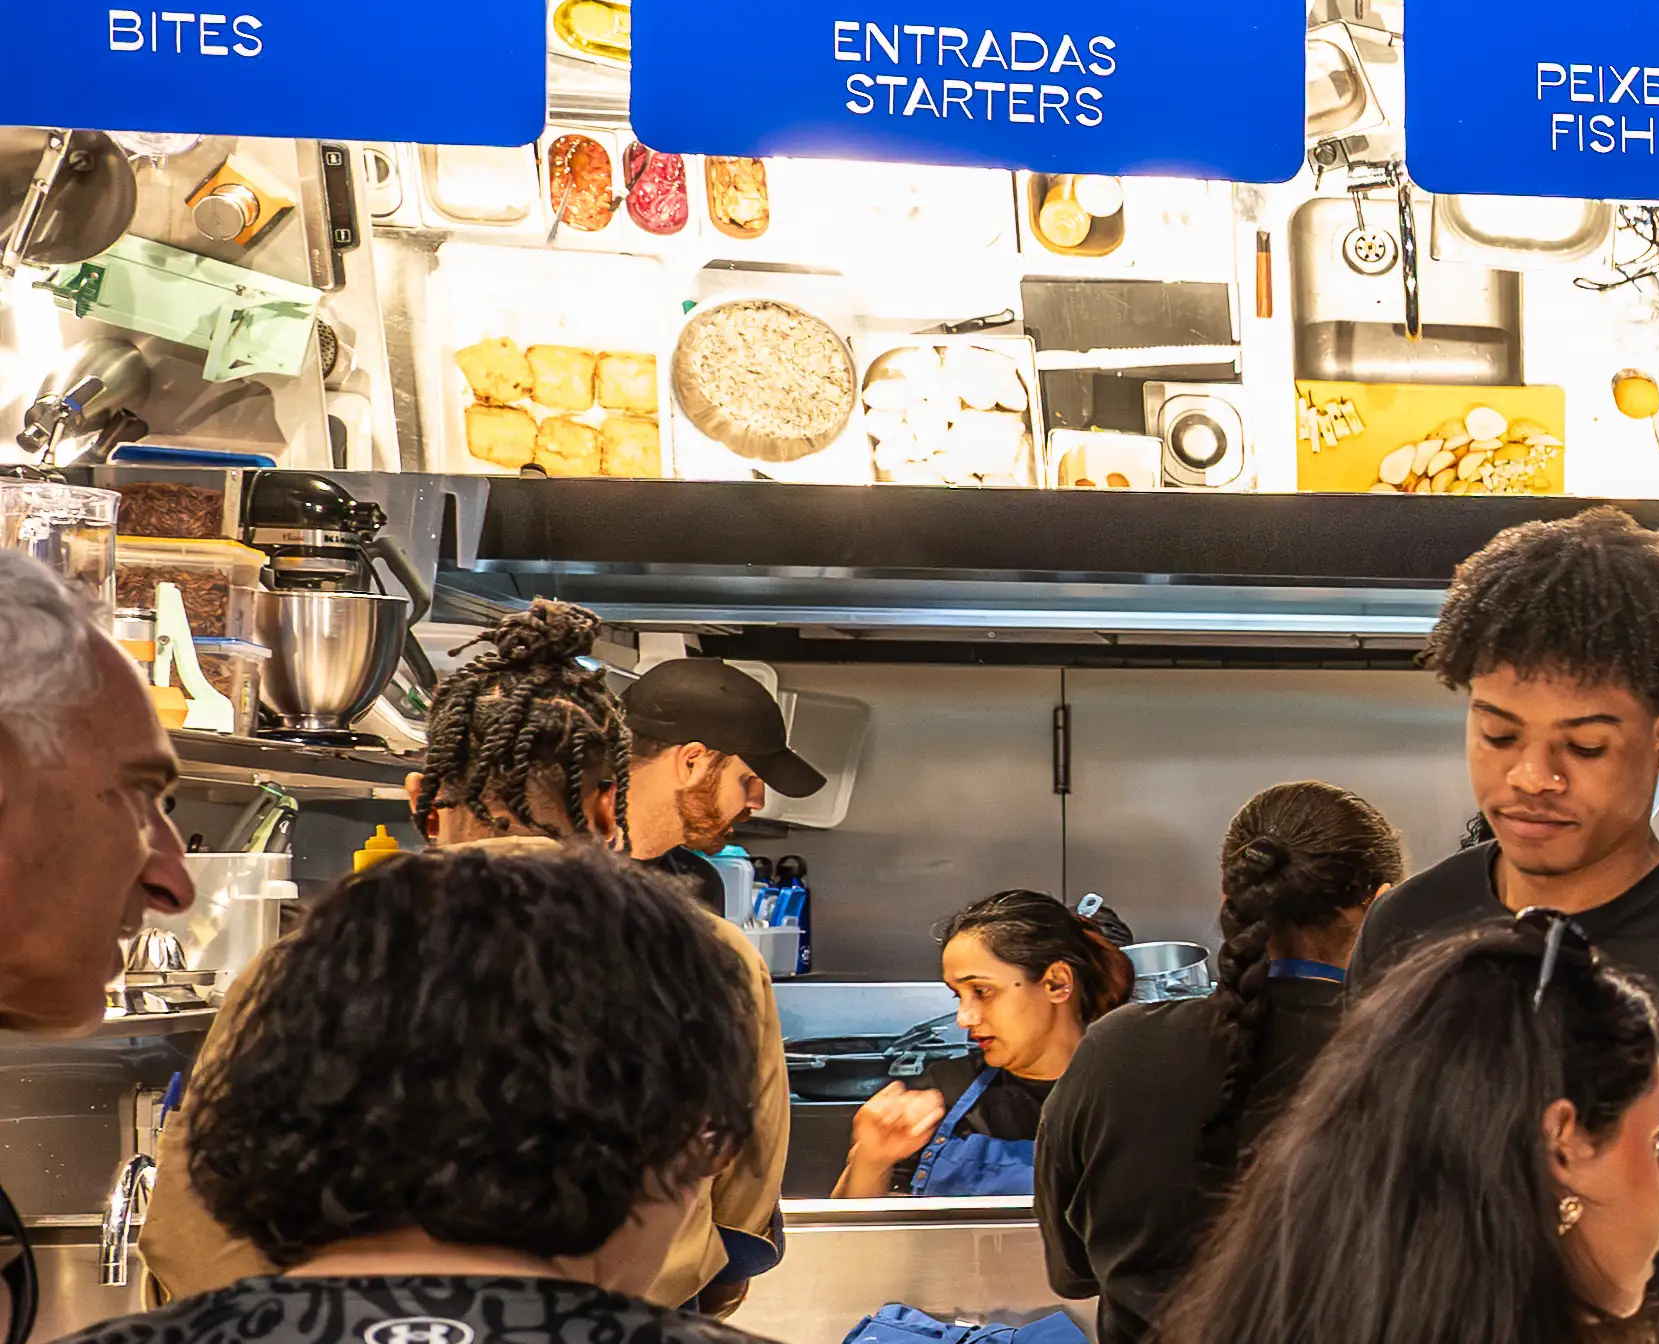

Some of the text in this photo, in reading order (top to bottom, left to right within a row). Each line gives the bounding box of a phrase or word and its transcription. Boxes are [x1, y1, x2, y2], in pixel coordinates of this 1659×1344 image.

[109, 10, 262, 56] BITES
[835, 21, 1115, 76] ENTRADAS
[846, 74, 1102, 126] STARTERS
[1552, 114, 1653, 154] FISH
